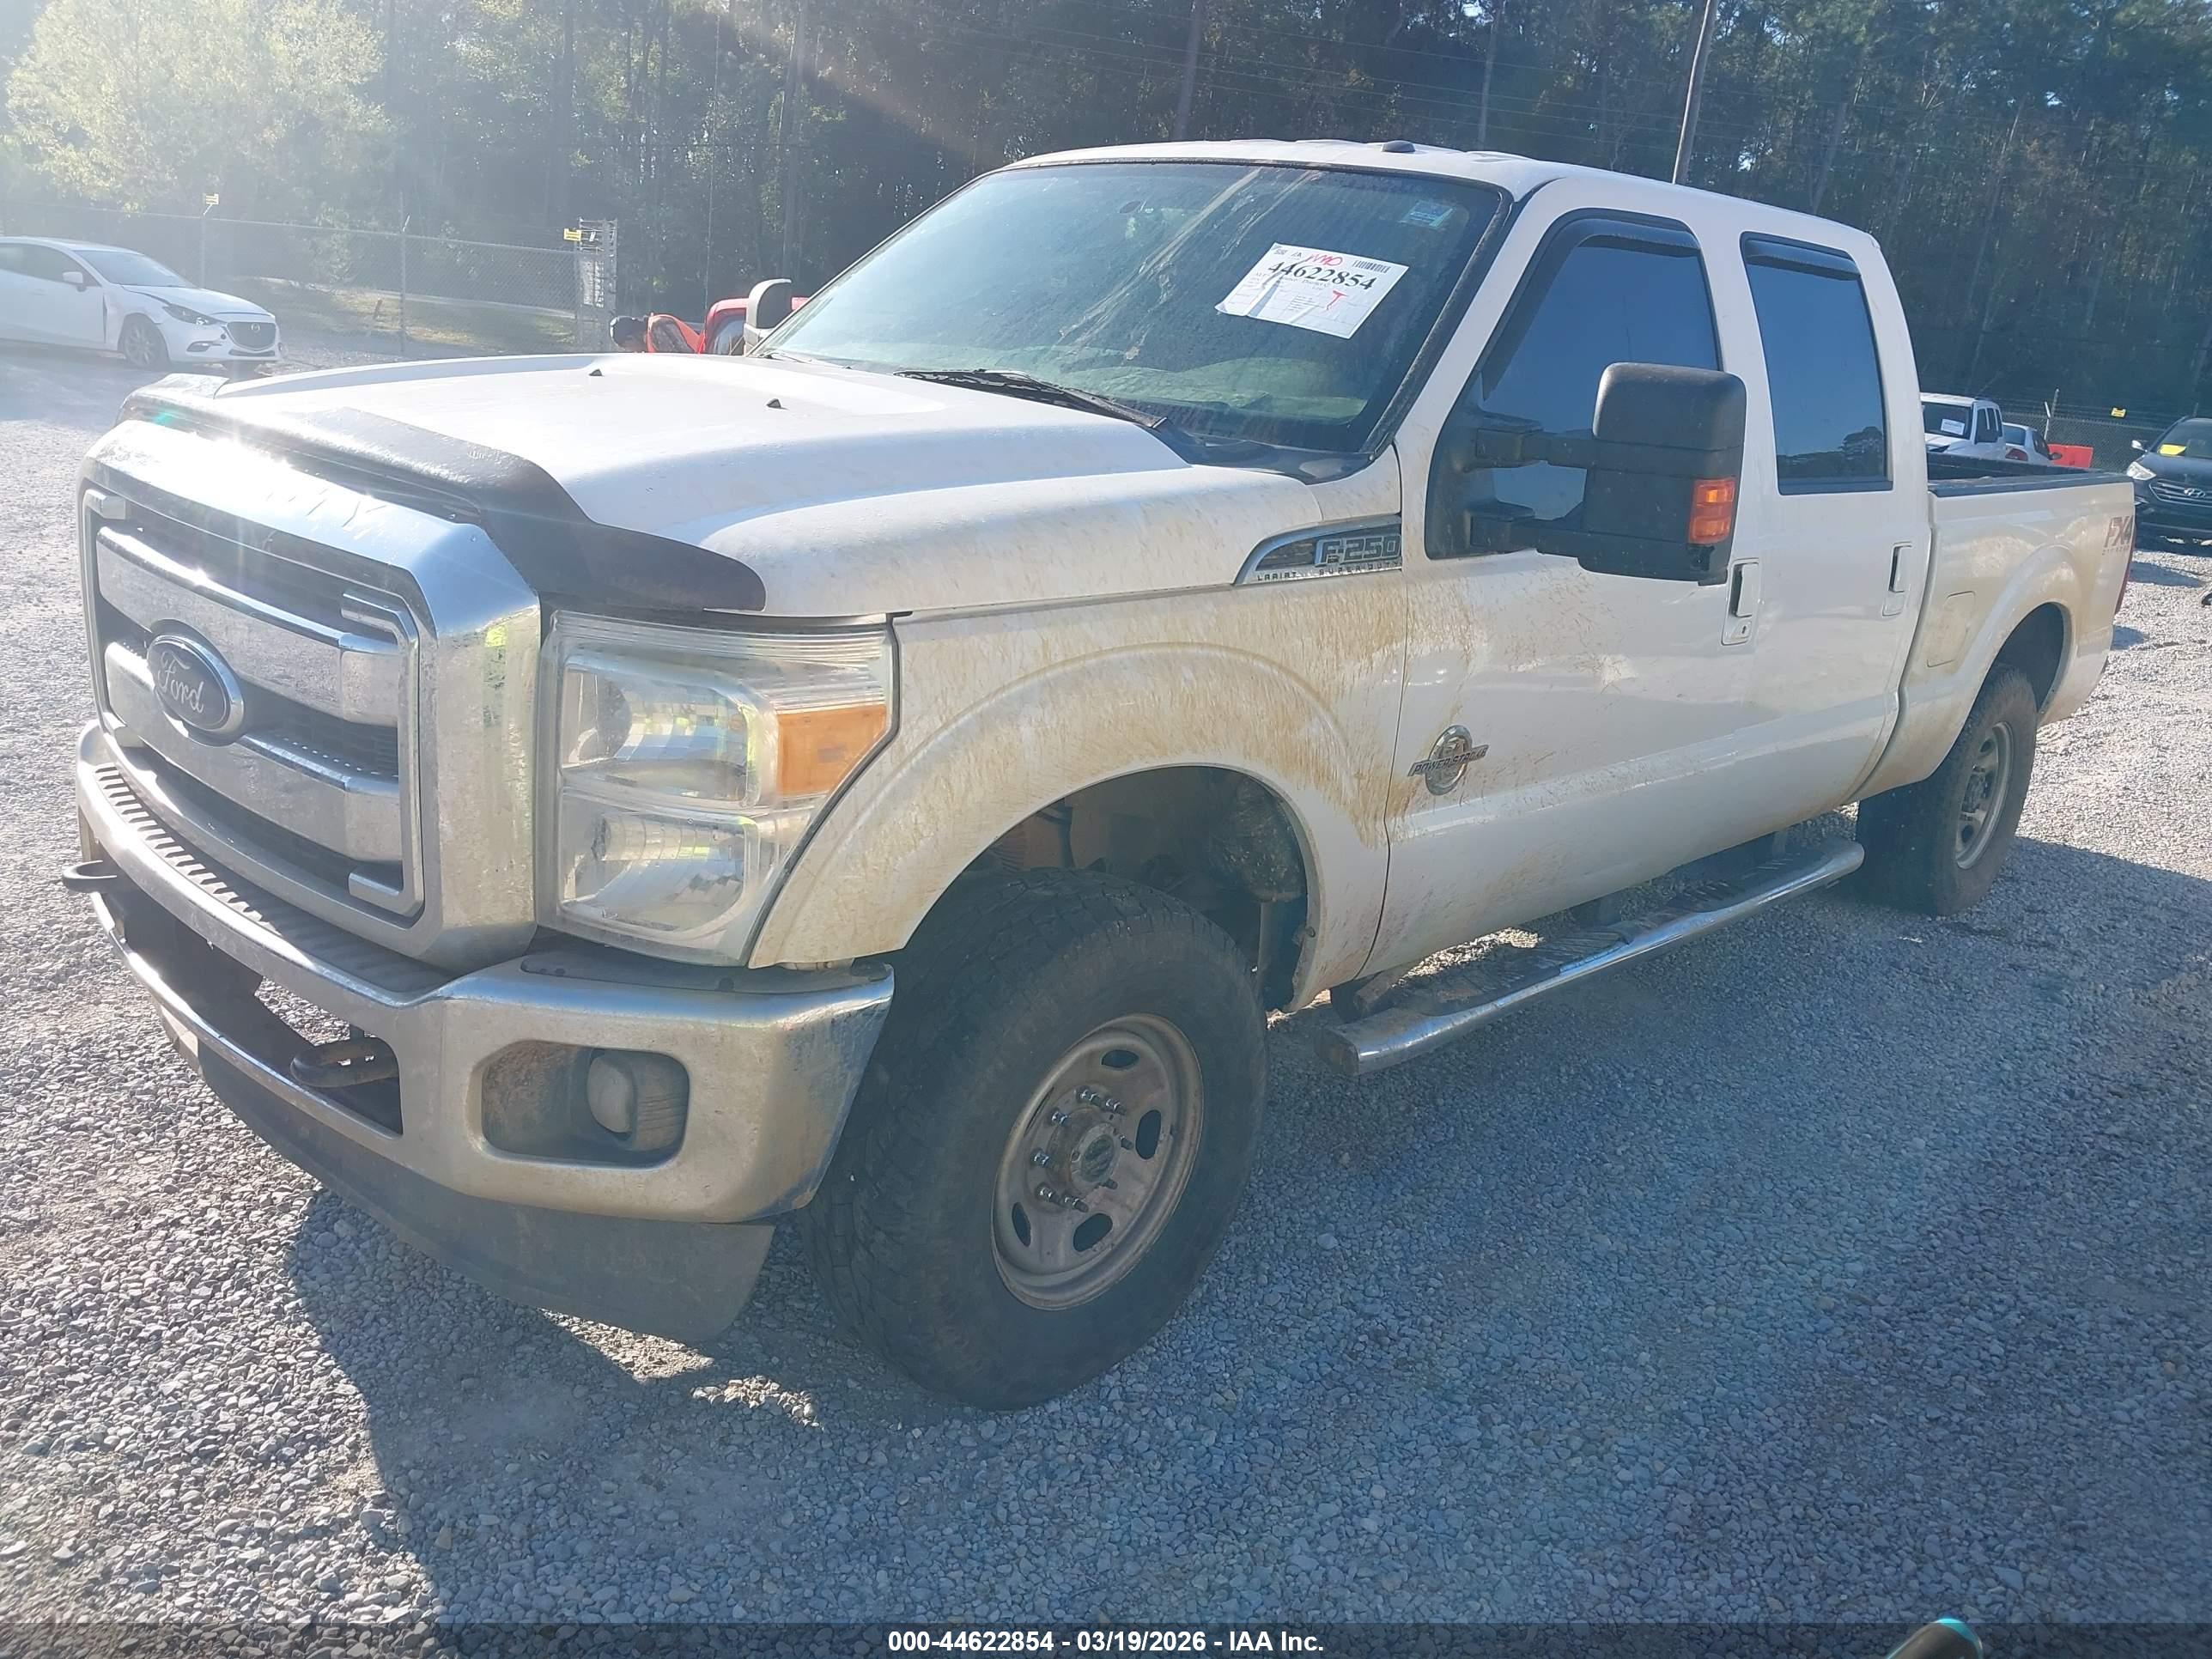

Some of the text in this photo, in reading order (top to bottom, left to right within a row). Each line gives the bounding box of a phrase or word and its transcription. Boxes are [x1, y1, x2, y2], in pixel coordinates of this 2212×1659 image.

[1267, 261, 1377, 290] 44622854
[1316, 535, 1401, 566] F-250
[1257, 571, 1297, 581] LARIAT
[1319, 565, 1361, 575] SUPER
[158, 651, 204, 714] Ford
